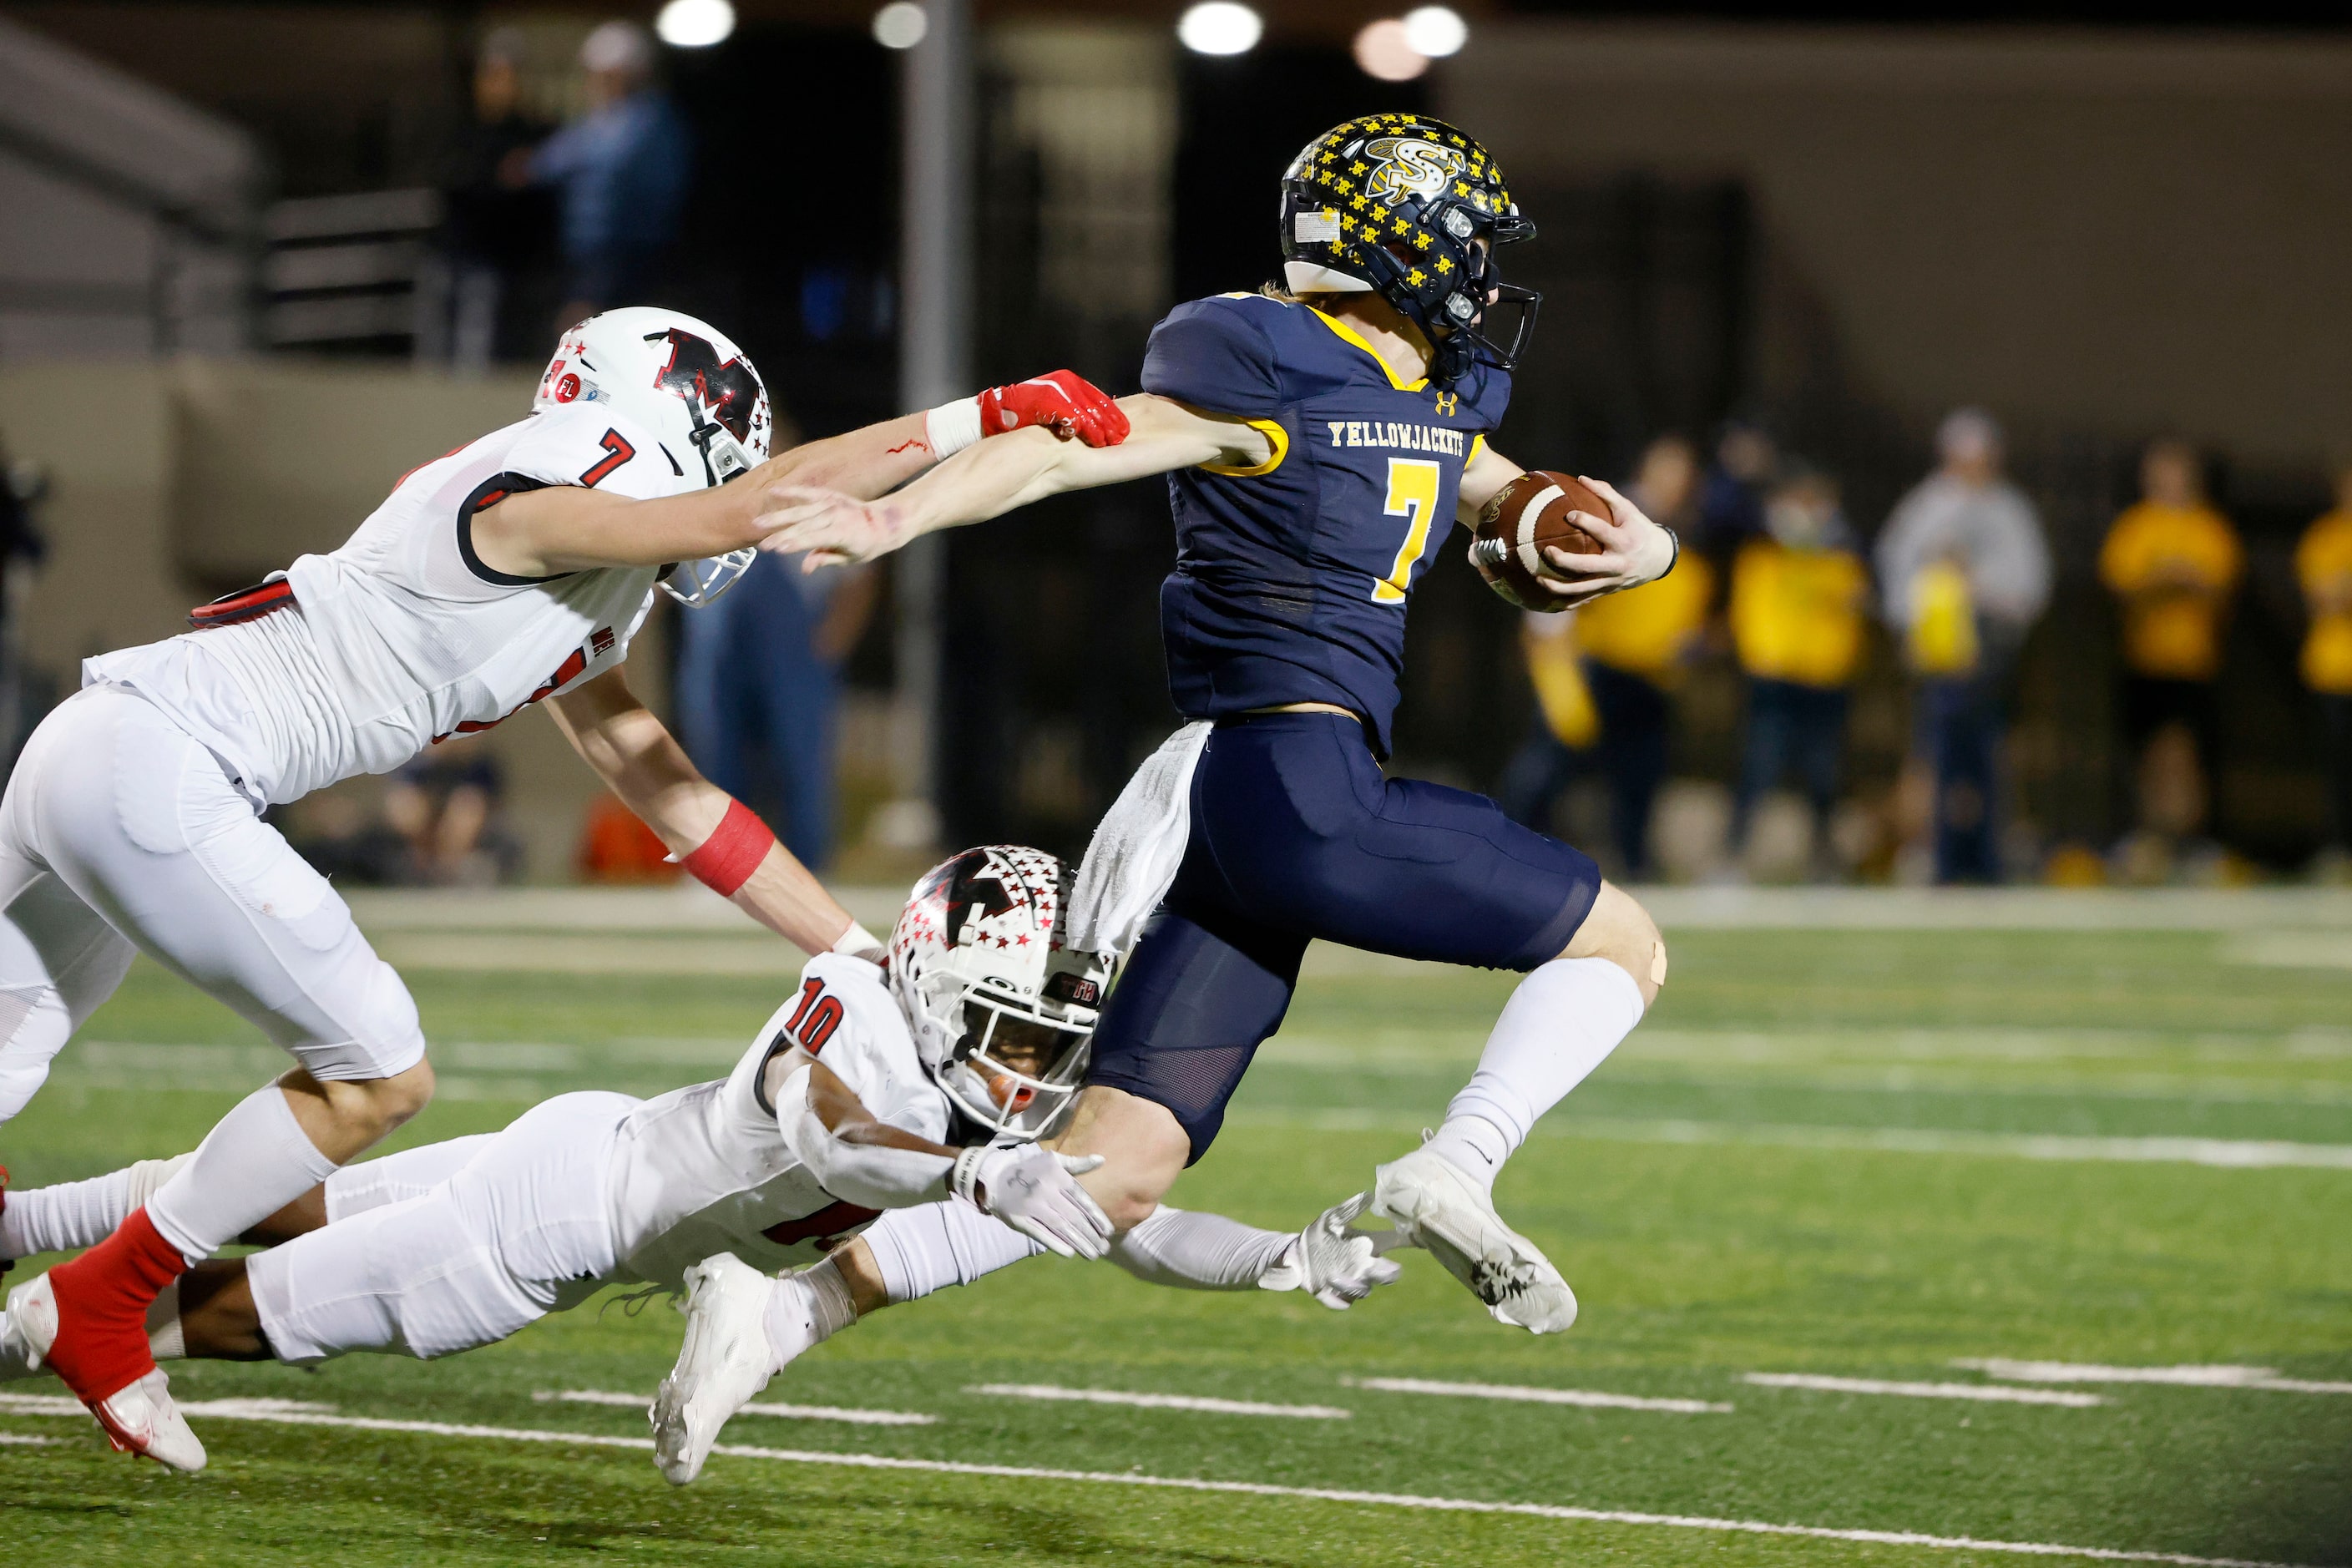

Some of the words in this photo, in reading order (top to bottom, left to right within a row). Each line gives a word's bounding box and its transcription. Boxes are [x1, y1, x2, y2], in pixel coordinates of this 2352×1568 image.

[1389, 140, 1449, 192] S
[558, 378, 574, 398] FL
[654, 327, 759, 444] M
[579, 427, 636, 488] 7
[1328, 422, 1464, 457] YELLOWJACKETS
[1370, 457, 1440, 604] 7
[785, 976, 844, 1056] 10
